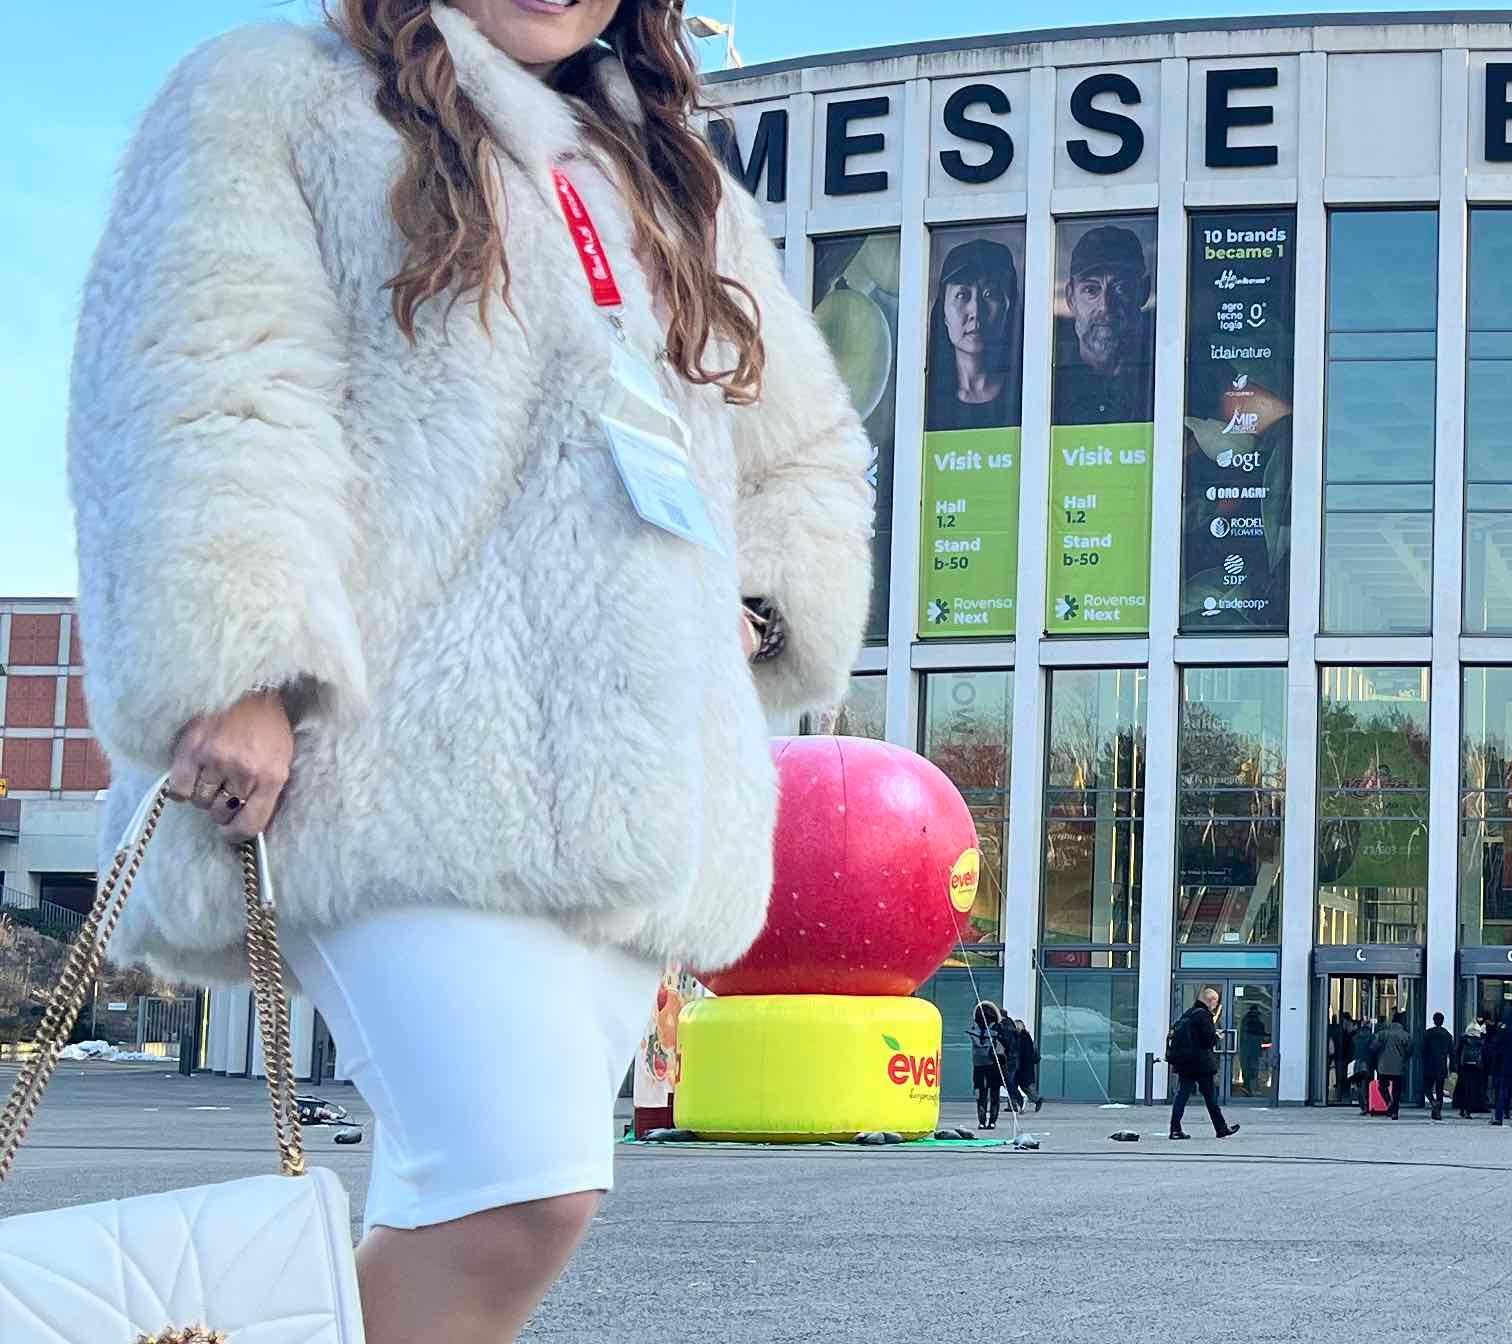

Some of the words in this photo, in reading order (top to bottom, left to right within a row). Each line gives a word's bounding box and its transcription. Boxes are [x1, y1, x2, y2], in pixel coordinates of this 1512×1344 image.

[707, 67, 1279, 202] MESSE
[1204, 230, 1222, 243] 10
[1226, 228, 1286, 243] brands
[1205, 247, 1273, 260] became
[1276, 244, 1284, 257] 1
[1221, 302, 1243, 315] agro
[934, 449, 983, 471] Visit
[988, 454, 1013, 468] us
[1062, 445, 1113, 466] Visit
[1119, 449, 1146, 464] us
[935, 499, 967, 513] Hall
[1063, 494, 1097, 509] Hall
[936, 515, 956, 528] 1.2
[1065, 511, 1086, 524] 1.2
[1230, 517, 1264, 528] RODEL
[934, 538, 981, 553] Stand
[1063, 534, 1112, 549] Stand
[934, 556, 969, 570] b-50
[1063, 553, 1099, 566] b-50
[1223, 575, 1245, 585] SDP
[953, 611, 989, 624] Next
[1083, 608, 1120, 622] Next
